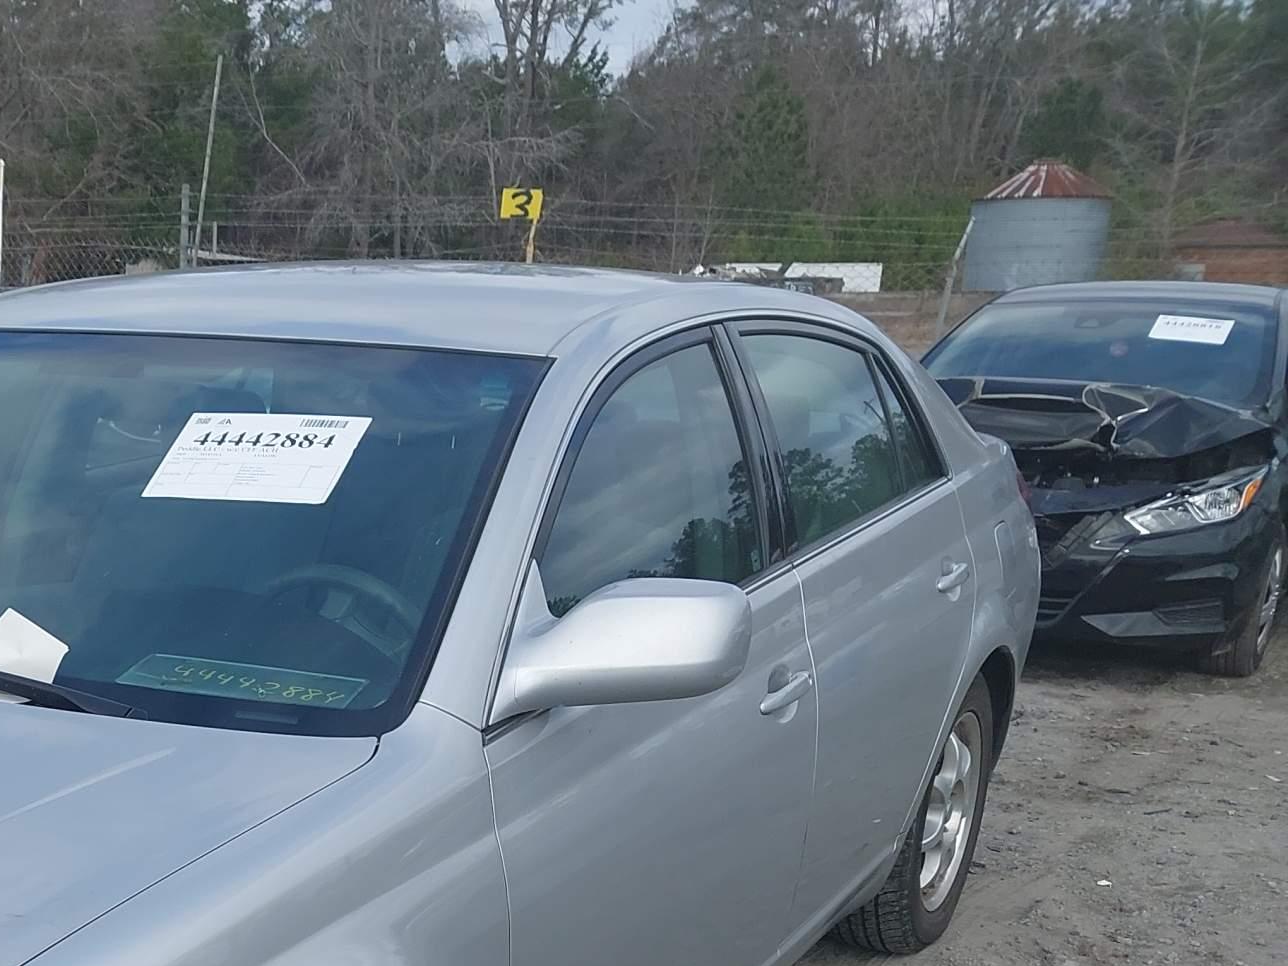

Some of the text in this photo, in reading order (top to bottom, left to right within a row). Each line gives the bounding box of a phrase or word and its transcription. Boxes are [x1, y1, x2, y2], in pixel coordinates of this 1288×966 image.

[510, 191, 533, 218] 3
[193, 431, 336, 450] 44442884
[174, 664, 345, 704] 44442884
